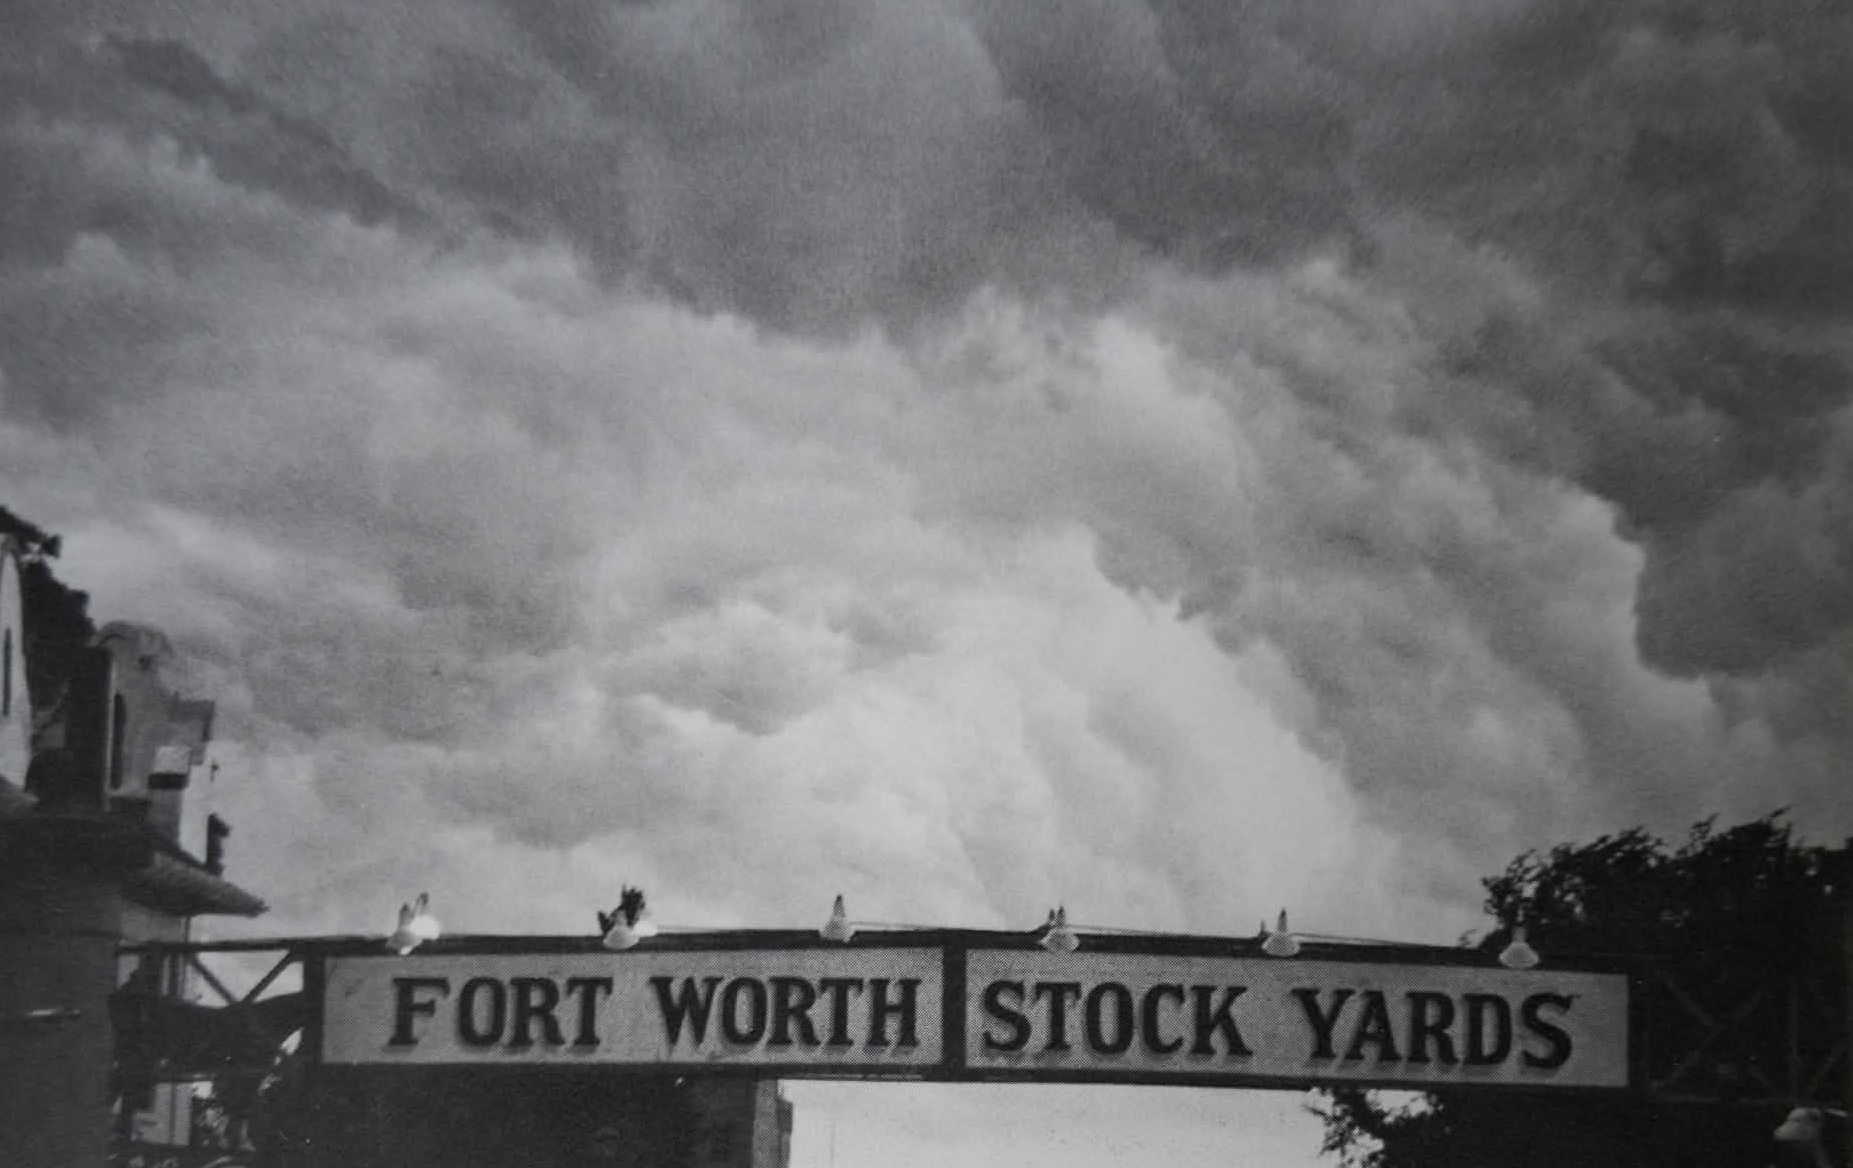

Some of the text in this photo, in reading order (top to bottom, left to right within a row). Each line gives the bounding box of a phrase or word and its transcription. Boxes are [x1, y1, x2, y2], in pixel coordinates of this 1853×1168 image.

[388, 976, 1578, 1069] FORT WORTH STOCK YARDS
